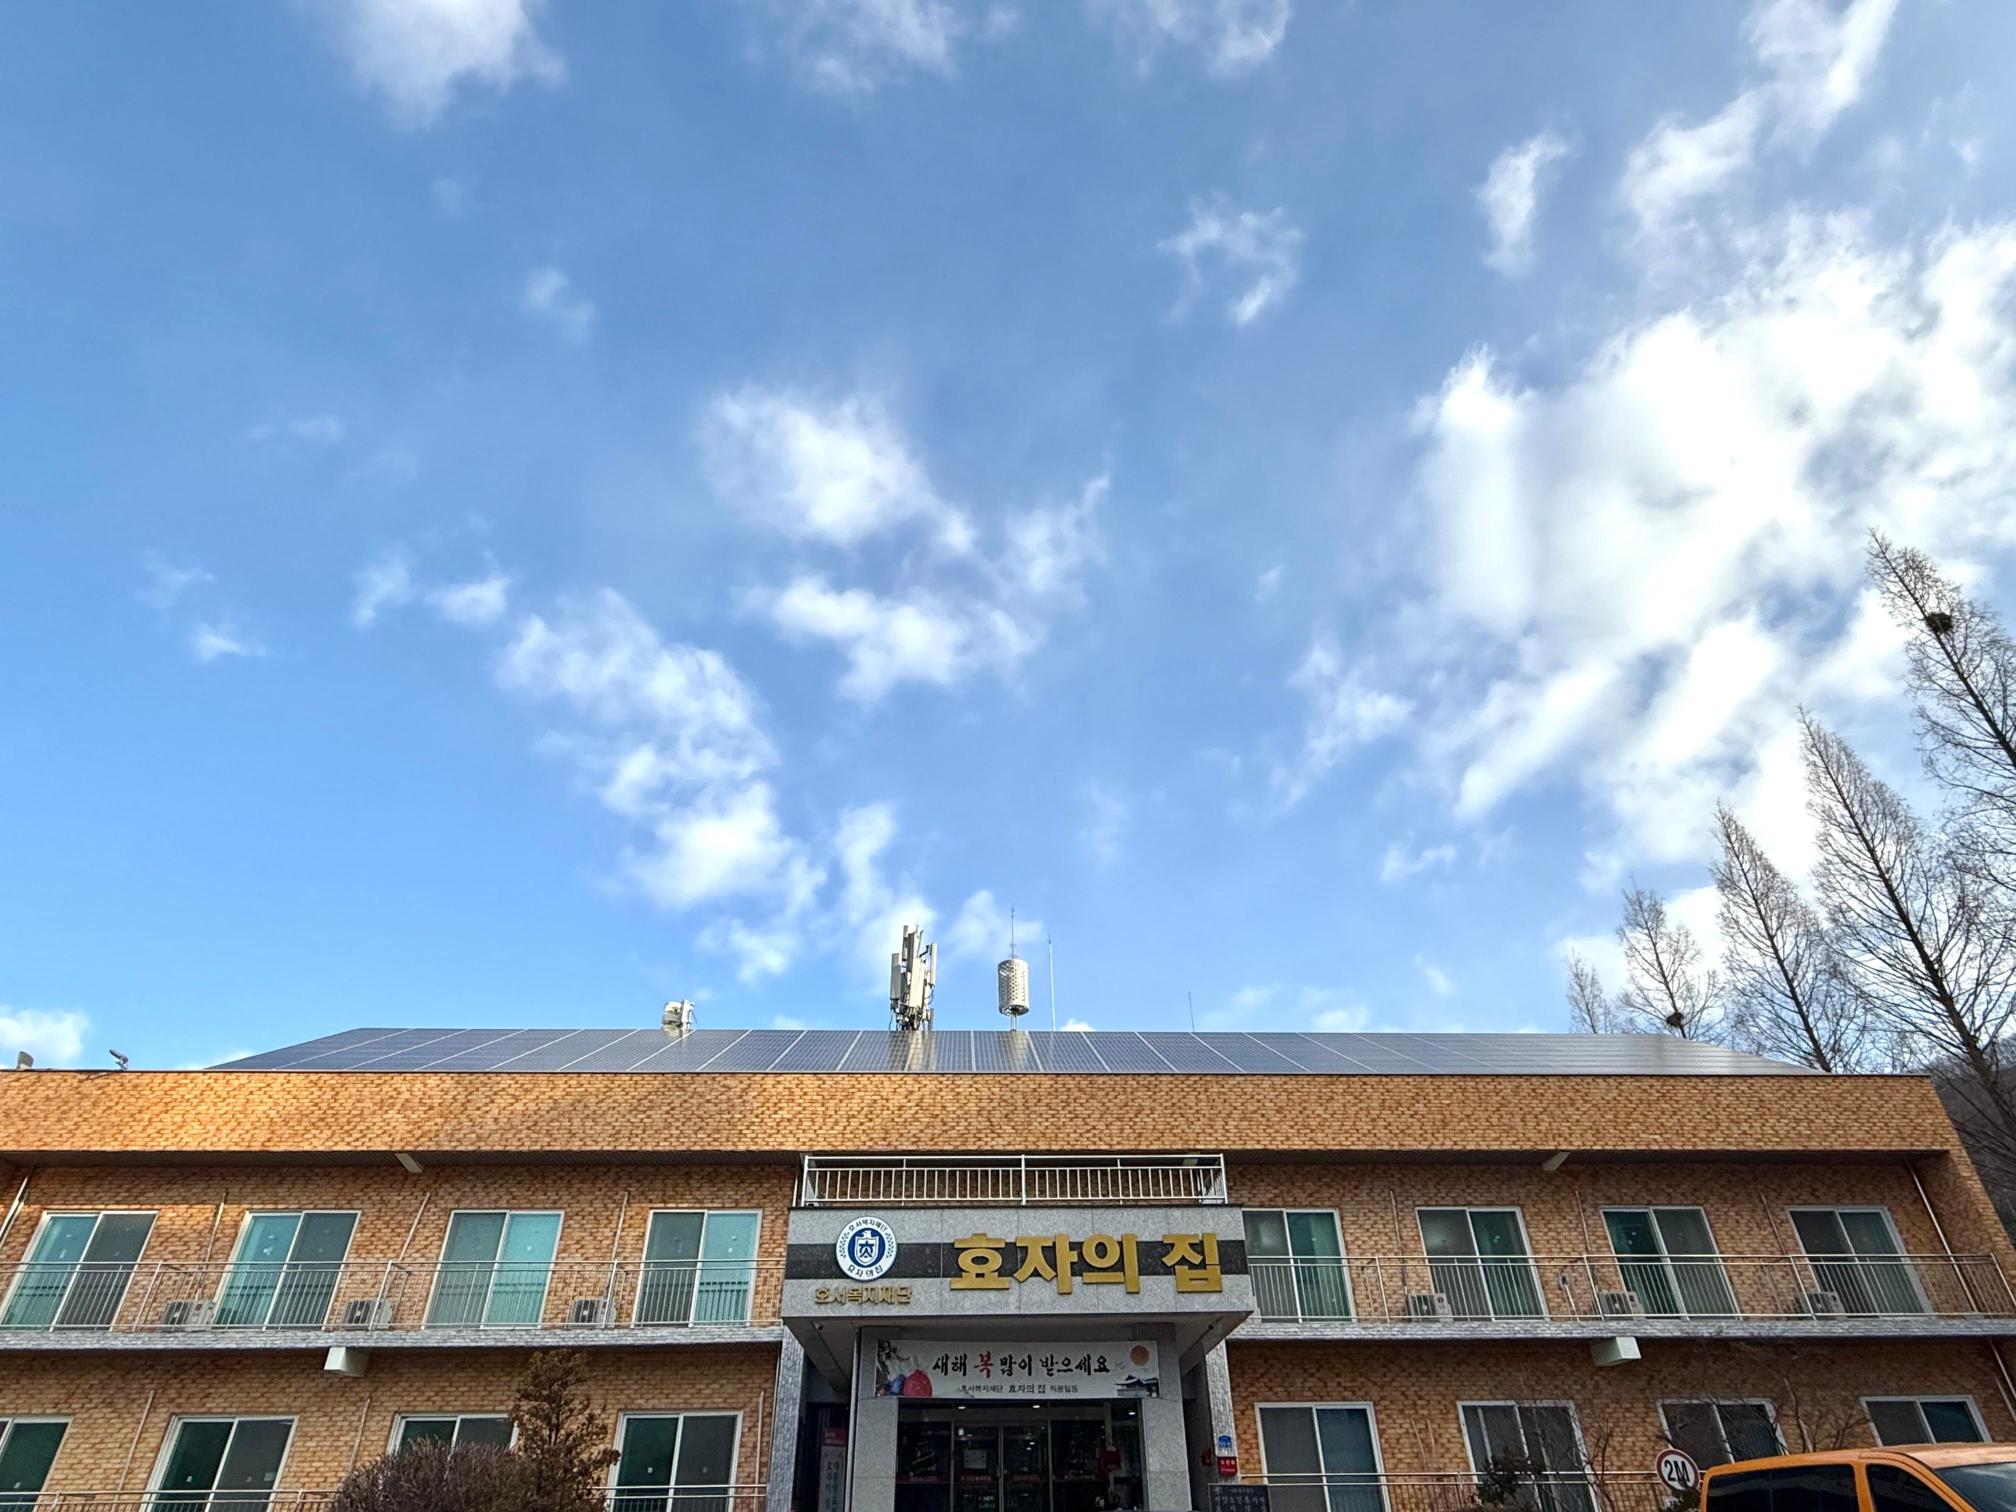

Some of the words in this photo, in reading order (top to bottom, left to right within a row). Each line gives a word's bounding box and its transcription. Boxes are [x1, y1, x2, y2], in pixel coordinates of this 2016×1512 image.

[949, 1233, 1140, 1294] 효자의
[1161, 1232, 1223, 1293] 집
[814, 1286, 913, 1305] 호서복지재단
[932, 1353, 967, 1376] 새해
[973, 1351, 994, 1379] 복
[999, 1354, 1032, 1377] 많이
[1040, 1353, 1110, 1377] 받으세요
[1664, 1460, 1690, 1482] 2M
